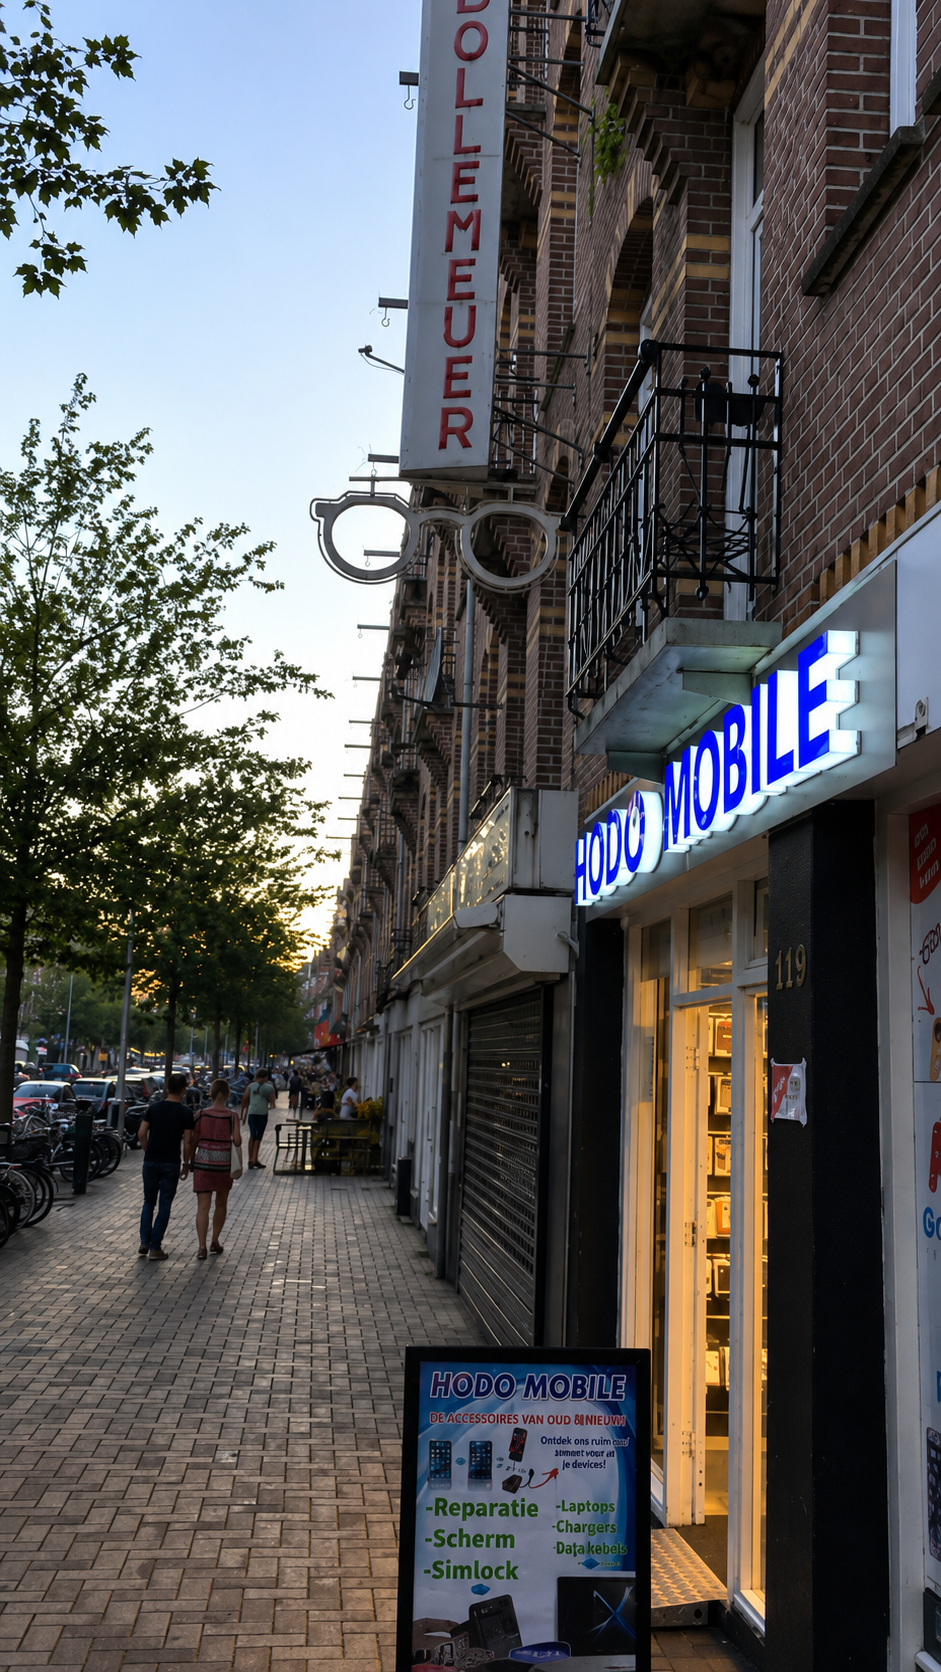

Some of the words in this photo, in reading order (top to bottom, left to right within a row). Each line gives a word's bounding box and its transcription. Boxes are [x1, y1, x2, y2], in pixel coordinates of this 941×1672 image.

[575, 790, 657, 906] HODO
[664, 630, 850, 852] MOBILE
[775, 944, 807, 991] 119
[429, 1371, 516, 1400] HODO
[522, 1373, 626, 1402] MOBILE
[429, 1412, 445, 1424] DE
[447, 1412, 519, 1425] ACCESSOIRES
[522, 1414, 544, 1426] VAN
[547, 1414, 571, 1426] OUD
[540, 1436, 572, 1446] Ontdek
[574, 1438, 590, 1446] ons
[591, 1437, 612, 1446] ruim
[572, 1460, 606, 1469] devices!
[426, 1498, 539, 1521] -Reparatie
[556, 1500, 616, 1515] -Laptops
[425, 1528, 515, 1549] -Scherm
[552, 1520, 618, 1537] -Chargers
[423, 1559, 519, 1580] -Simlock
